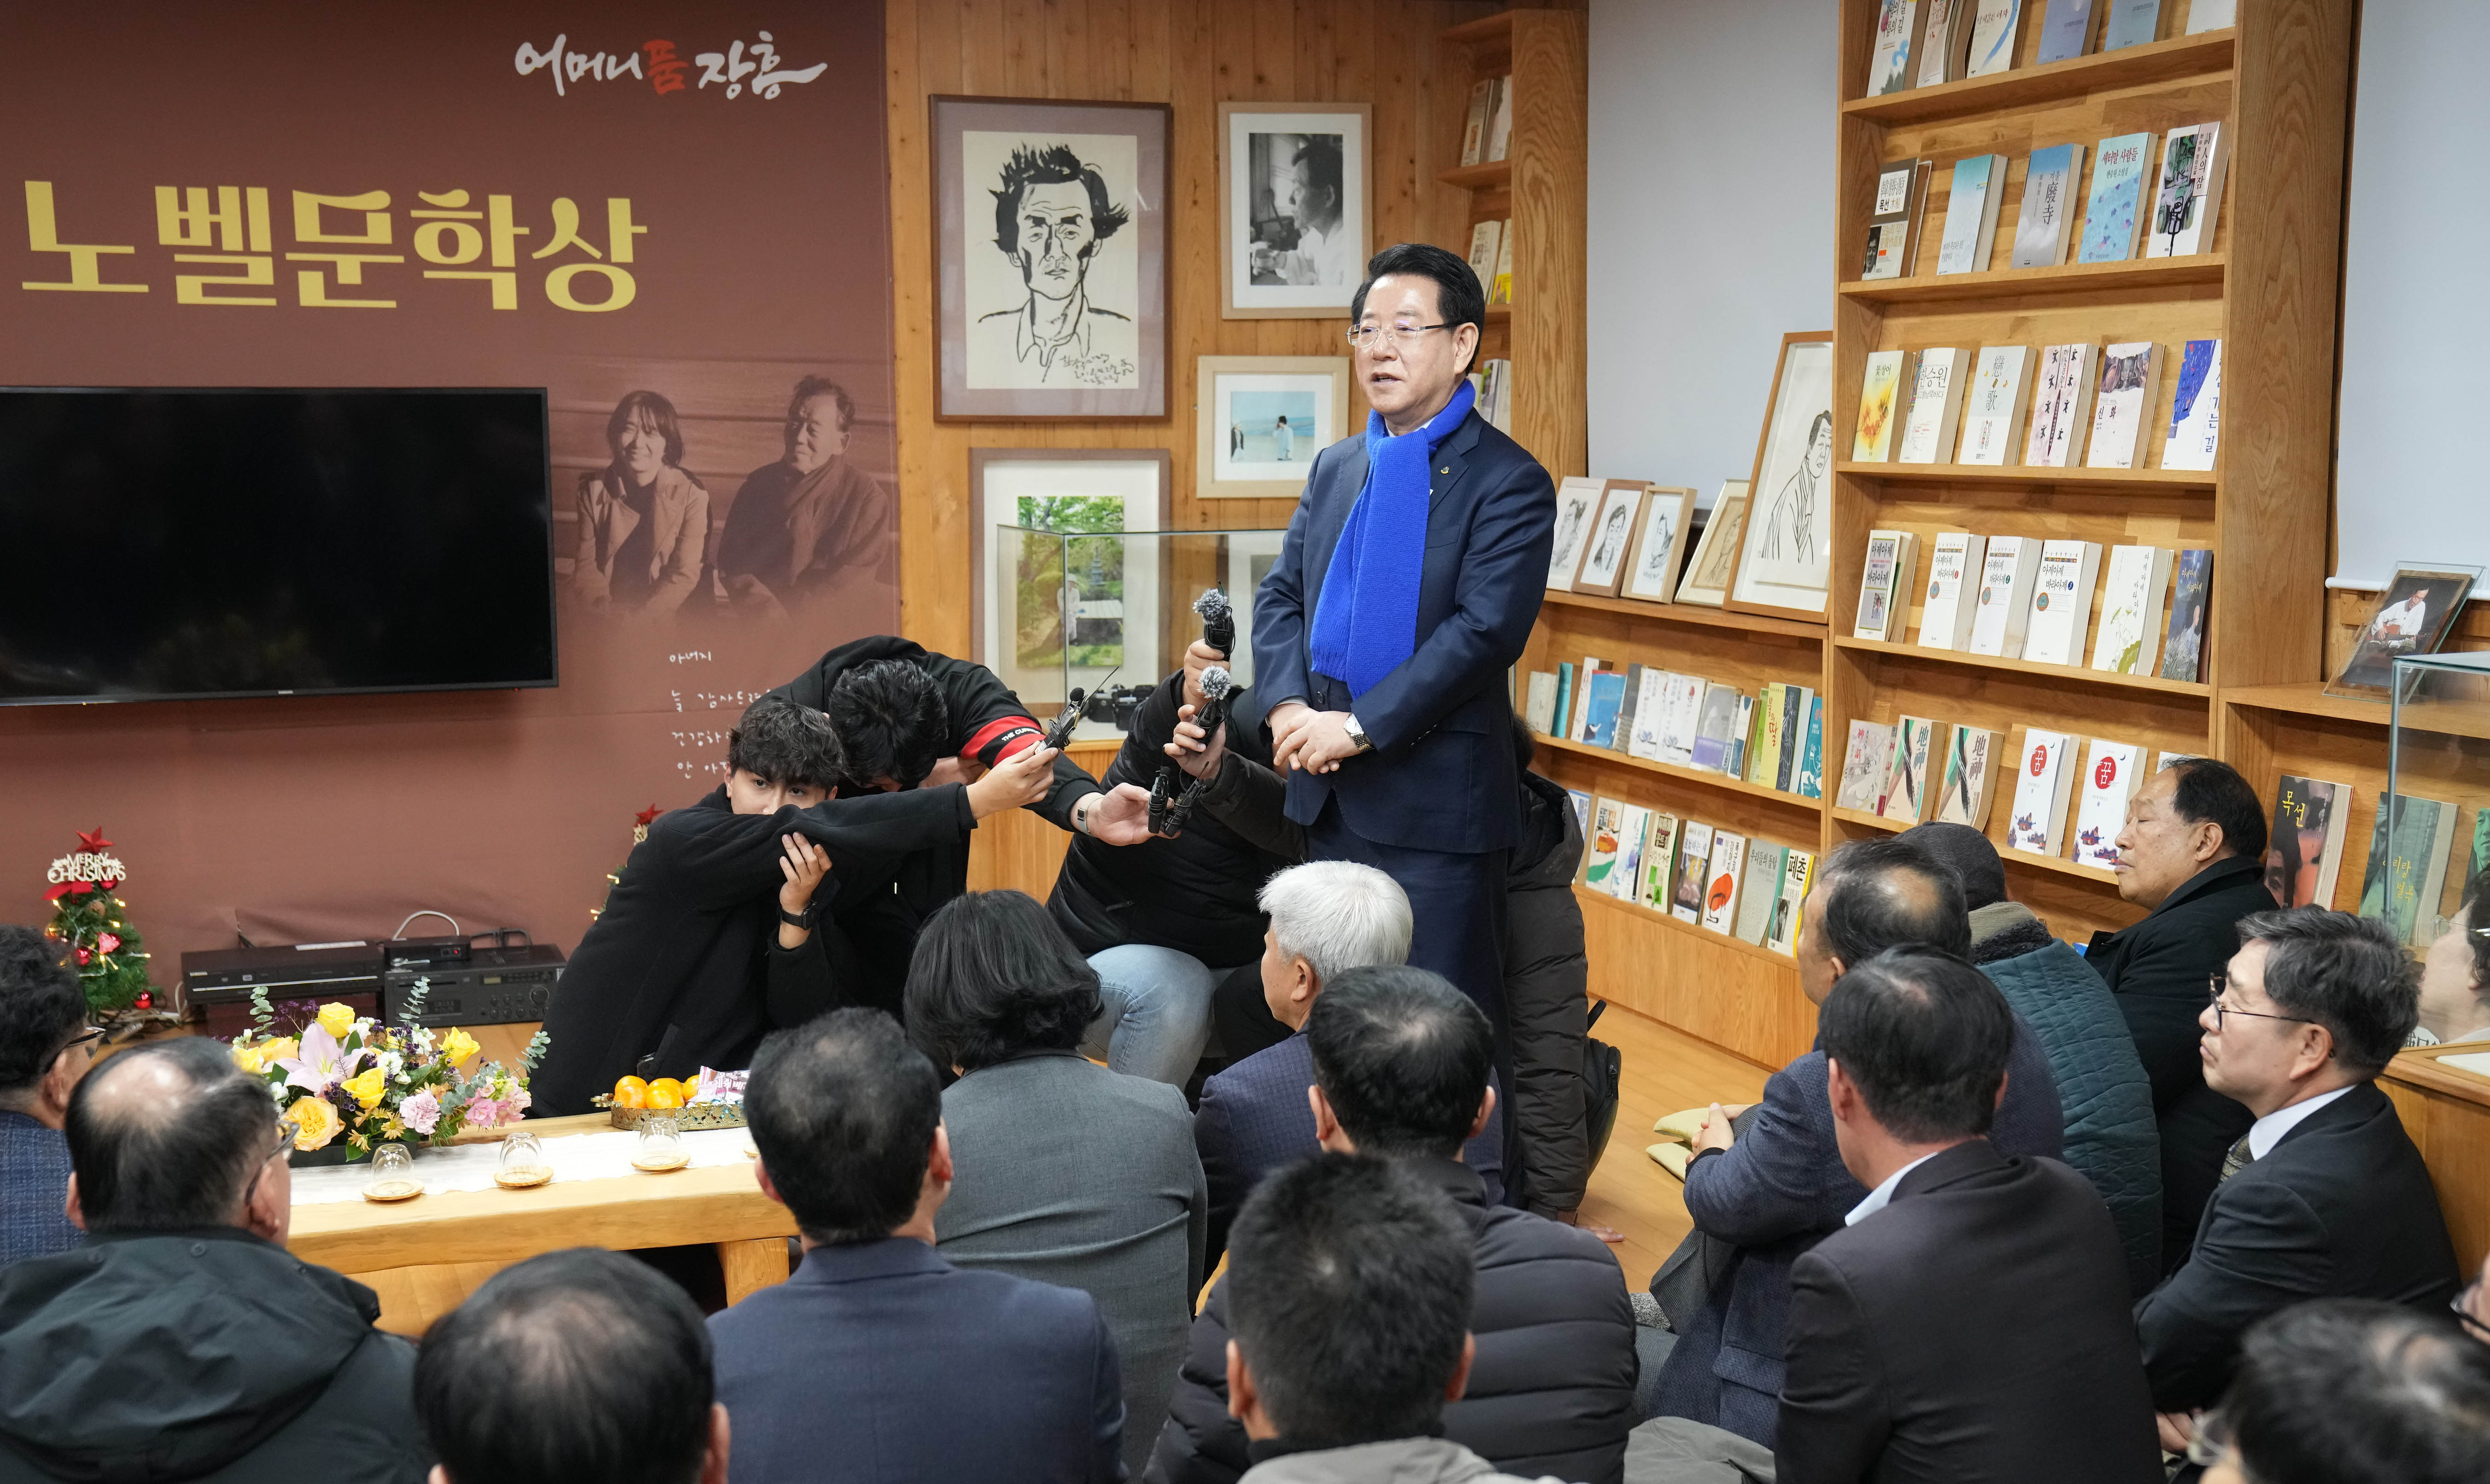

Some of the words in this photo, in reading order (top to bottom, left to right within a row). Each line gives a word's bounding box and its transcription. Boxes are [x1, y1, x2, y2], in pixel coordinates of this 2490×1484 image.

[694, 31, 828, 100] 장흥
[2101, 149, 2118, 166] 새터말
[2120, 147, 2139, 163] 사람들
[2106, 169, 2117, 179] 한승원
[2195, 175, 2205, 189] 잠
[1879, 198, 1889, 213] 목선
[22, 180, 647, 313] 노벨문학상
[1920, 367, 1948, 388] 한승원
[2205, 436, 2215, 452] 길
[1872, 541, 1893, 558] 아제아제
[1936, 555, 1953, 567] 아제아제
[1988, 559, 2004, 571] 아제아제
[1868, 570, 1889, 586] 바라아제
[1937, 568, 1955, 580] 바라아제
[2042, 564, 2064, 577] 아제아제
[1990, 574, 2006, 585] 바라아제
[2046, 579, 2068, 592] 바라아제
[671, 731, 731, 747] 건강하
[1001, 732, 1016, 741] THE
[1769, 721, 1778, 747] 딸
[1913, 726, 1929, 770] 地神
[1968, 735, 1986, 781] 地神
[2034, 750, 2044, 772] 꿈
[2100, 762, 2112, 785] 꿈
[2282, 791, 2306, 828] 목선
[66, 852, 109, 867] MERRY
[1750, 849, 1768, 867] 우리들의
[1768, 853, 1777, 870] 돌탑
[1788, 855, 1806, 881] 폐촌
[2383, 856, 2412, 879] 리랑
[47, 864, 127, 883] CHRISTMAS
[2397, 881, 2414, 905] 별곡
[710, 1077, 747, 1090] 레쉬베
